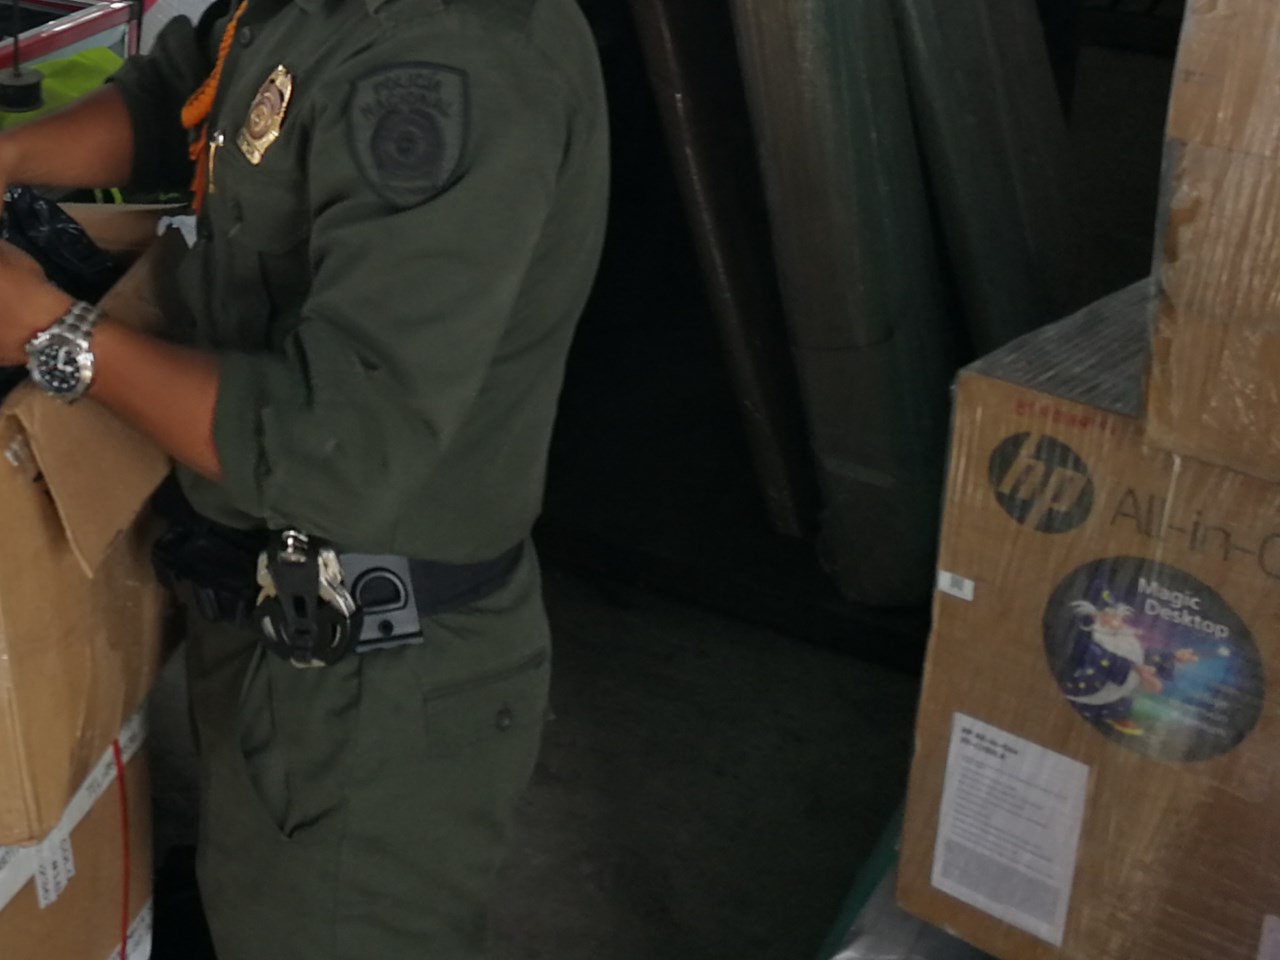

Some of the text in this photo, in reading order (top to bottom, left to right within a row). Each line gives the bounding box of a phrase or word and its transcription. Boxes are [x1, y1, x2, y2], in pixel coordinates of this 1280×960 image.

[999, 431, 1088, 533] hp
[1137, 577, 1202, 611] Magic
[1143, 597, 1231, 639] Desktop
